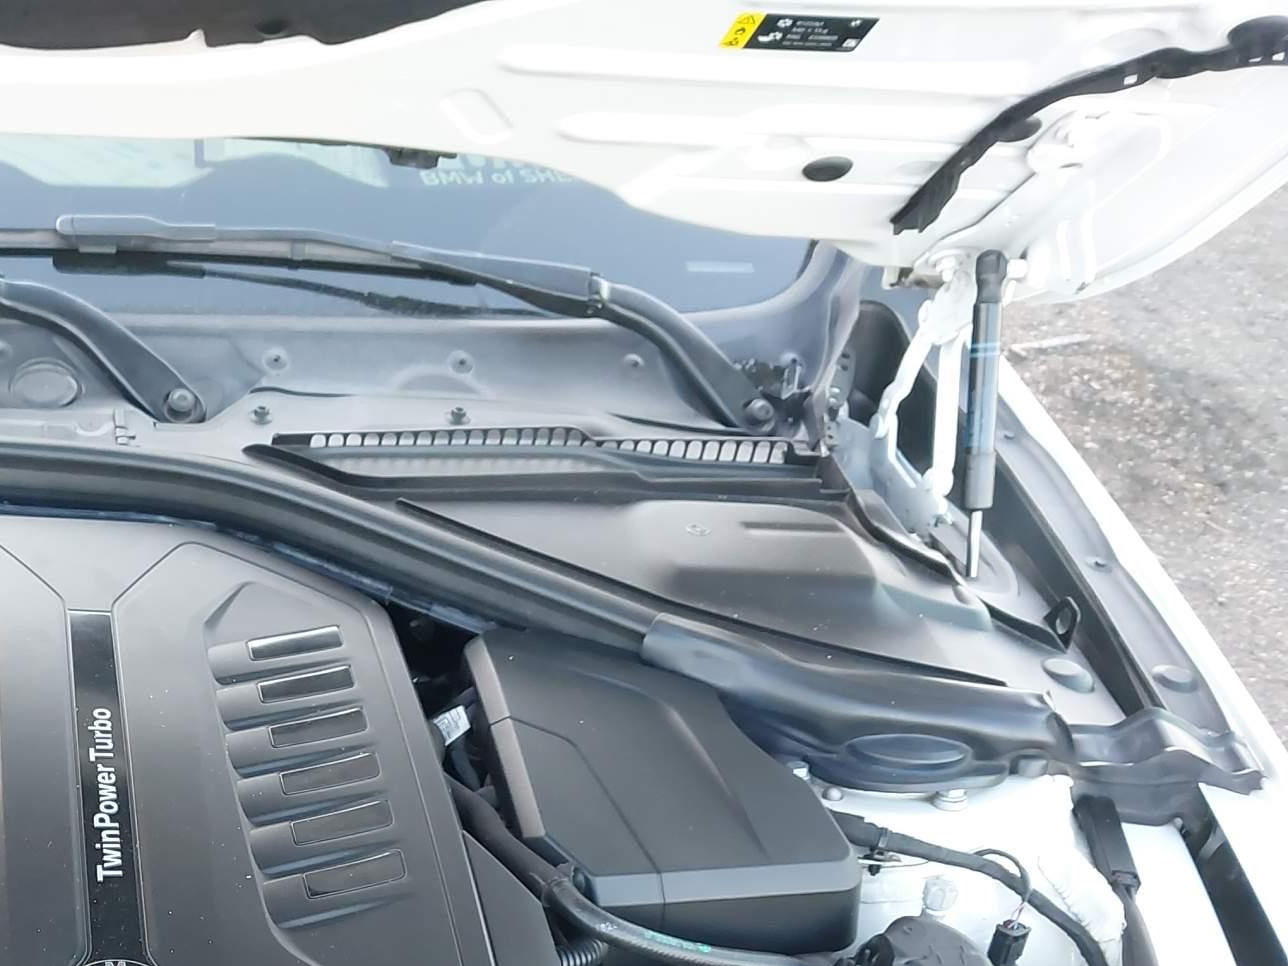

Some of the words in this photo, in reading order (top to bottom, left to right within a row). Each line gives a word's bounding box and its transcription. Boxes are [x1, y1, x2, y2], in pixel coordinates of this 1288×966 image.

[419, 169, 484, 186] BMW
[490, 168, 514, 185] of
[87, 707, 114, 762] Turbo
[93, 763, 123, 882] TwinPower
